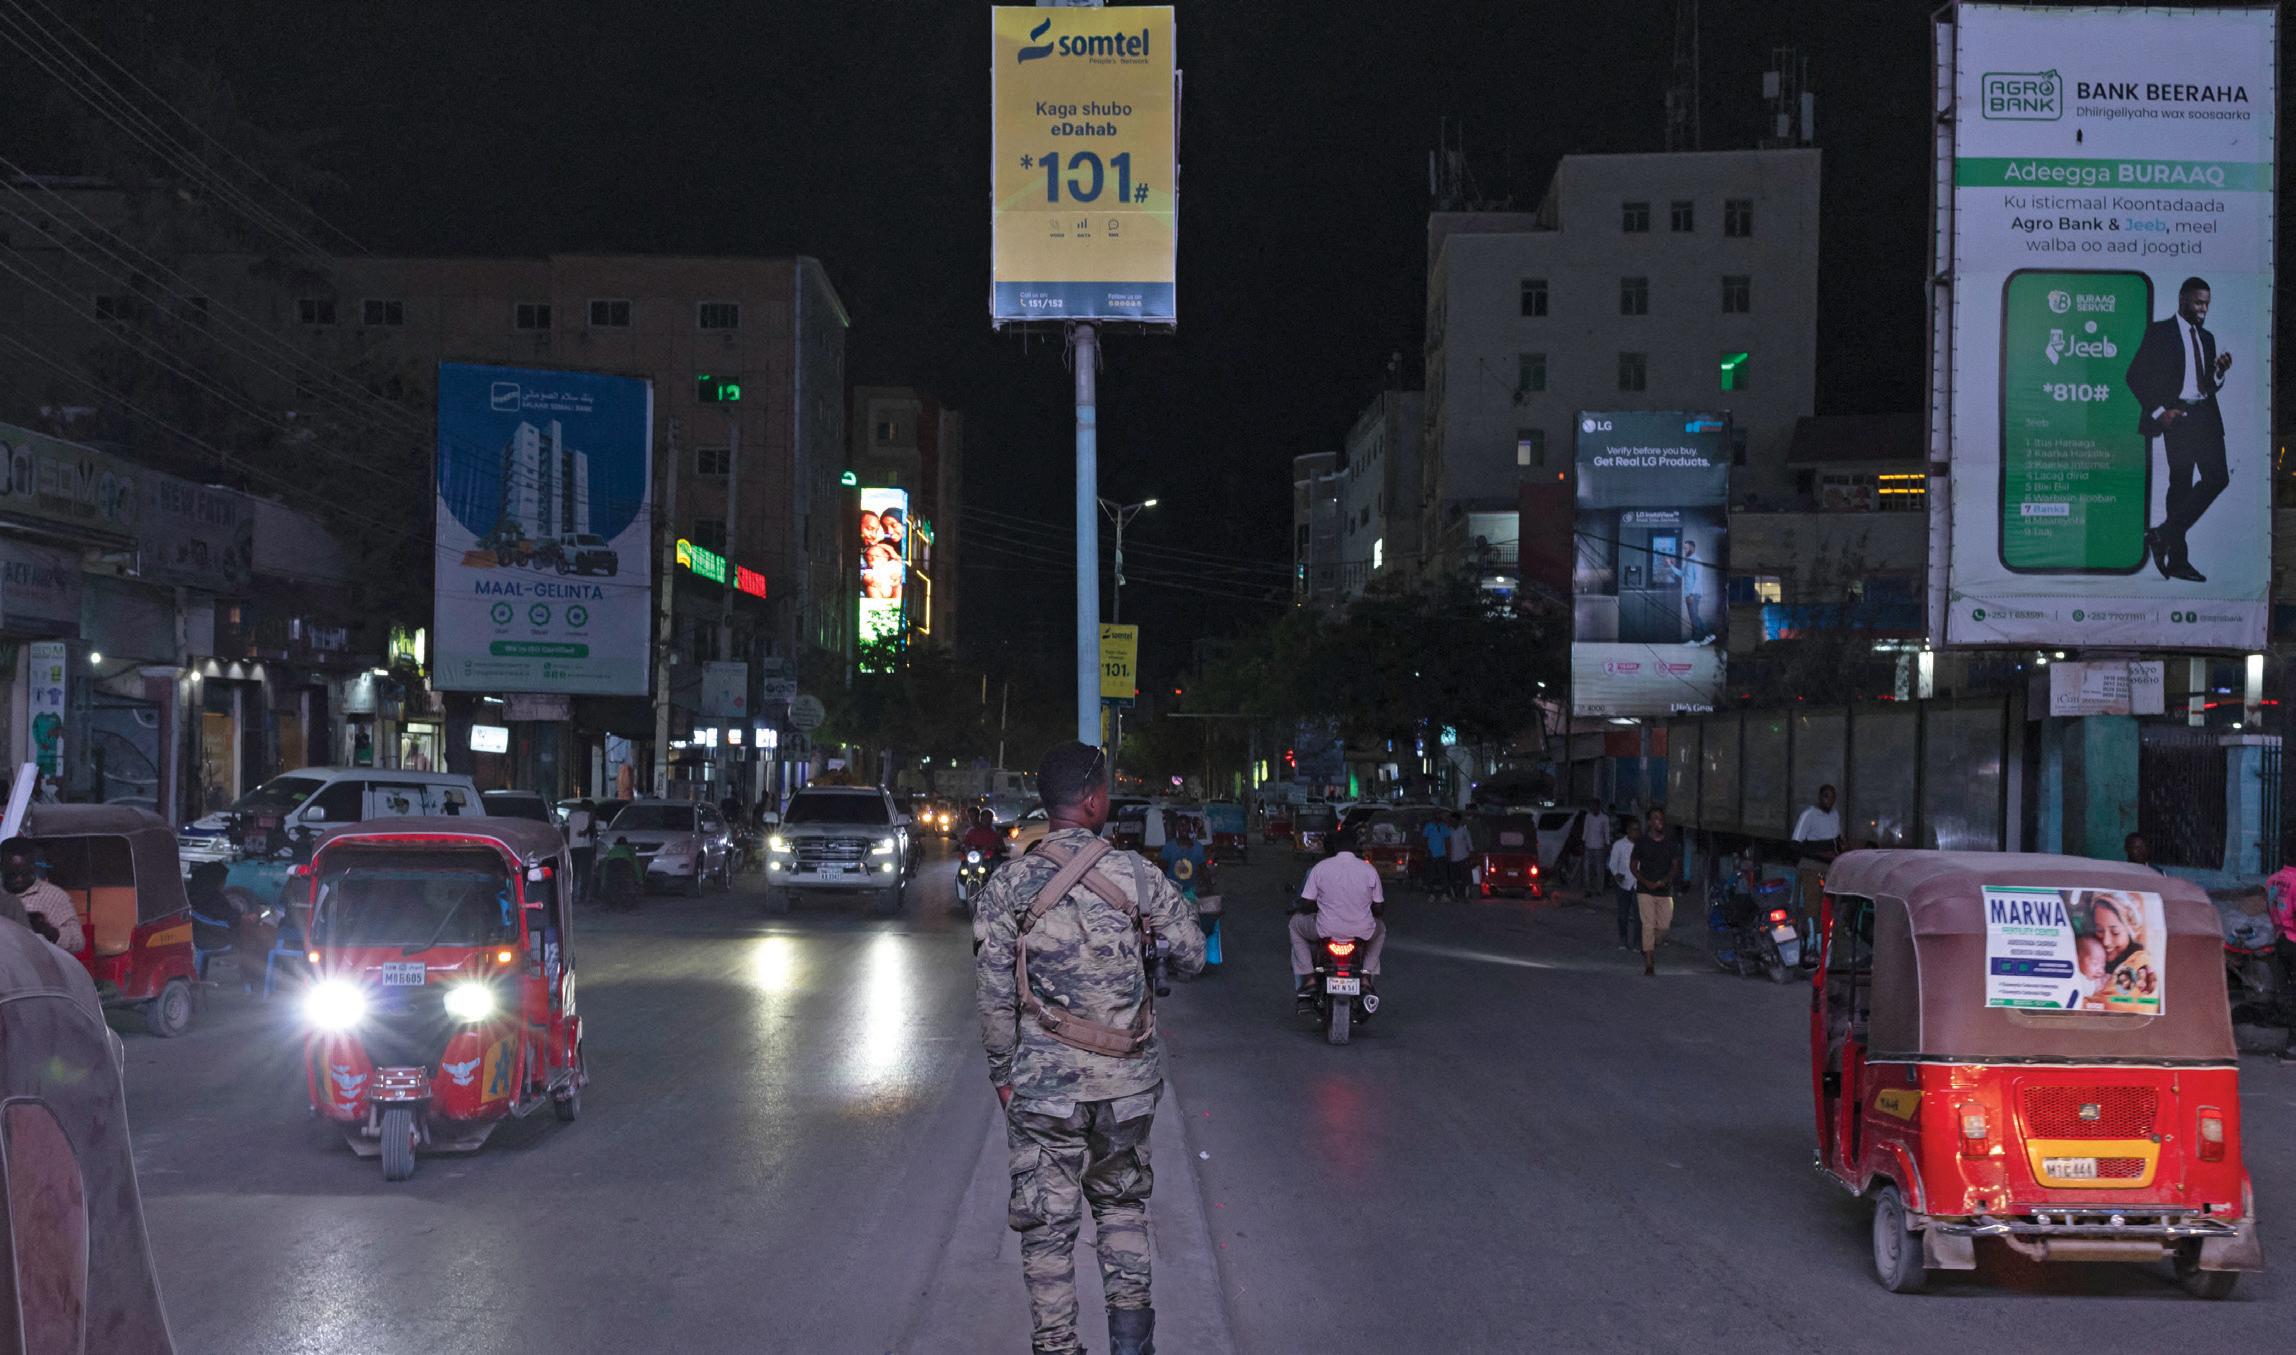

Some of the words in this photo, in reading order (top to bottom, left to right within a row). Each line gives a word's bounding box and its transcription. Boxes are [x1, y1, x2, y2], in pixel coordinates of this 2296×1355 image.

[1059, 28, 1149, 56] somtel
[1990, 81, 2054, 97] AGRO
[2077, 82, 2139, 101] BANK
[2146, 83, 2249, 103] BEERAHA
[1036, 101, 1077, 119] Kaga
[1082, 101, 1132, 116] shubo
[1990, 98, 2054, 112] BANK
[2161, 109, 2185, 119] wax
[2188, 108, 2251, 121] soosaarka
[1051, 122, 1117, 136] eDahab
[2004, 161, 2110, 186] Adeegga
[2117, 164, 2225, 187] BURAAQ
[2004, 196, 2027, 209] Ku
[2032, 195, 2107, 210] isticmaal
[2112, 197, 2225, 213] Koontadaada
[2011, 217, 2054, 233] Agro
[2059, 217, 2103, 231] Bank
[2108, 219, 2120, 231] &
[2175, 220, 2217, 234] meel
[2026, 239, 2077, 253] walba
[2081, 242, 2102, 253] oo
[2107, 239, 2137, 253] aad
[2142, 240, 2202, 257] joogtid
[2076, 294, 2116, 304] BURAAQ
[2077, 303, 2115, 312] SERVICE
[2064, 335, 2117, 358] Jeeb
[1597, 421, 1612, 431] LG
[1607, 446, 1632, 456] Verify
[1633, 446, 1661, 455] before
[1662, 448, 1679, 456] you
[1680, 446, 1698, 457] buy.
[1593, 456, 1613, 466] Get
[1615, 456, 1640, 466] Real
[1641, 457, 1657, 466] LG
[1658, 457, 1710, 467] Products.
[475, 580, 604, 600] MAAL-GELINTA
[1111, 632, 1133, 640] somtel
[1990, 899, 2067, 927] MARWA
